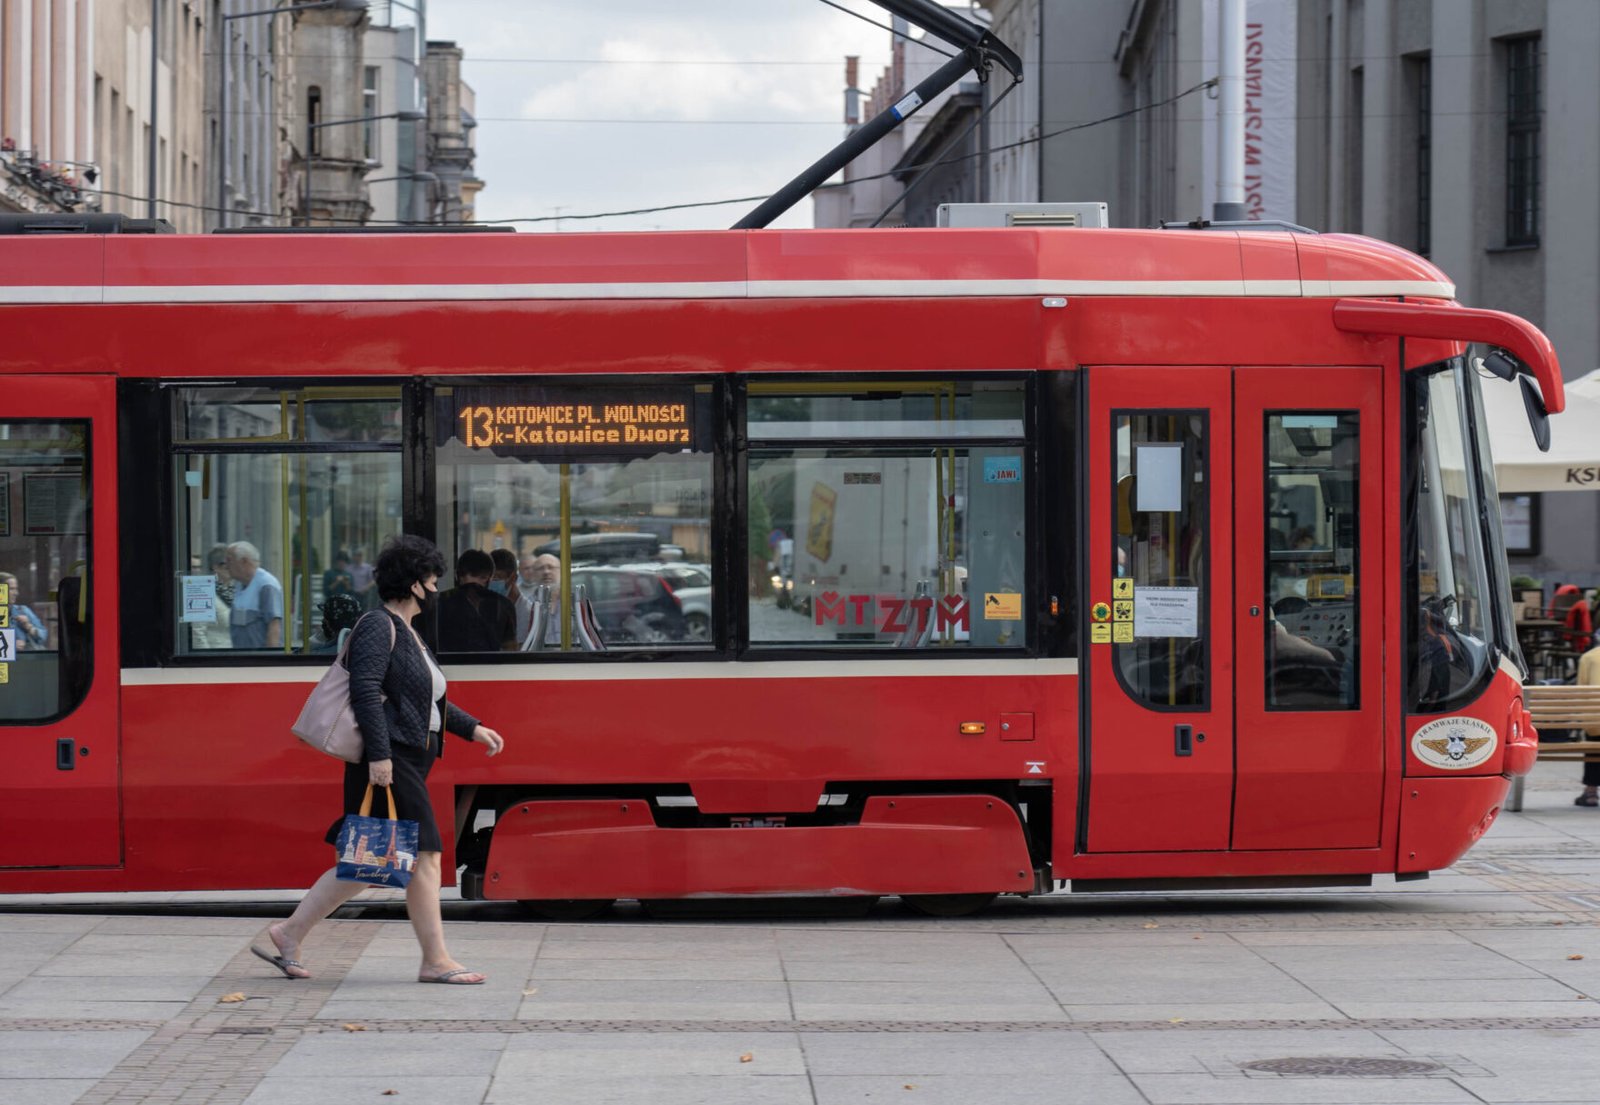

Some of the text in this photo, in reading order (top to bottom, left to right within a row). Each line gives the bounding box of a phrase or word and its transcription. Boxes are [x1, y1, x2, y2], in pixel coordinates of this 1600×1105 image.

[496, 404, 685, 424] KATOWICE PL. WOLNOŚCI
[459, 406, 494, 447] 13
[625, 424, 689, 442] Dworz
[881, 594, 970, 633] ZTM
[1418, 719, 1459, 738] TRAMWAJE
